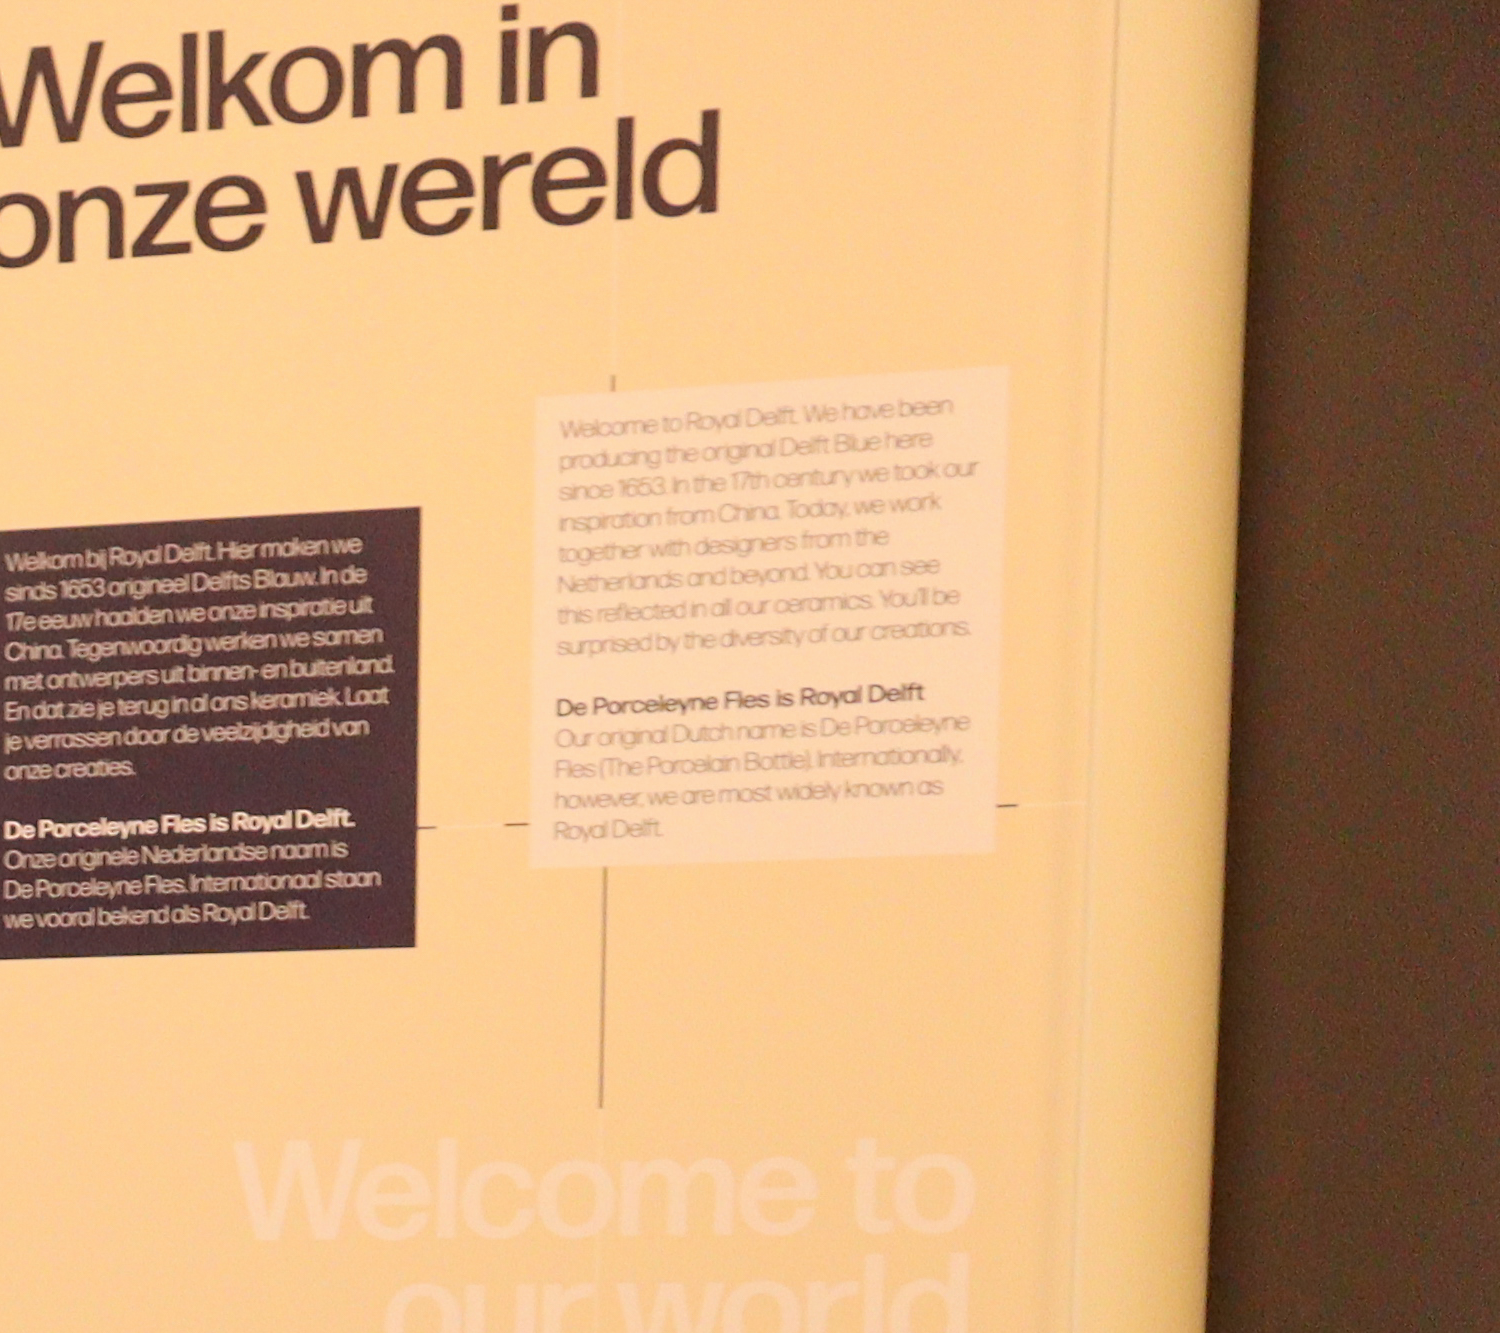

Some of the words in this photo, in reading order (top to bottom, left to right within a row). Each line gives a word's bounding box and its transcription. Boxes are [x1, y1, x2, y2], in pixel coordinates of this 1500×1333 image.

[500, 4, 598, 105] in
[294, 109, 720, 244] wereld
[558, 418, 659, 439] Welcome
[661, 415, 682, 434] to
[686, 411, 740, 432] Royal
[802, 404, 838, 424] We
[841, 402, 894, 421] have
[896, 399, 954, 418] been
[558, 449, 661, 474] producing
[666, 445, 700, 464] the
[701, 439, 776, 465] original
[779, 435, 829, 457] Delft
[834, 432, 881, 454] Blue
[884, 432, 934, 450] here
[558, 511, 662, 534] inspiration
[666, 507, 714, 526] from
[853, 498, 886, 515] we
[888, 492, 942, 513] work
[4, 551, 84, 572] Welkom
[84, 549, 106, 570] bij
[108, 546, 163, 568] Royal
[216, 541, 258, 560] Hier
[260, 538, 330, 558] maken
[330, 538, 364, 554] we
[558, 542, 646, 567] together
[648, 538, 690, 558] with
[694, 535, 797, 559] designers
[801, 530, 851, 550] from
[854, 528, 890, 548] the
[4, 581, 57, 602] sinds
[59, 577, 106, 599] 1653
[108, 574, 190, 600] origineel
[191, 571, 252, 592] Delfts
[320, 566, 338, 585] In
[340, 565, 368, 585] de
[557, 570, 684, 593] Netherlands
[686, 567, 726, 588] and
[813, 561, 852, 580] You
[856, 561, 896, 579] can
[899, 558, 940, 576] see
[4, 611, 37, 631] 17e
[38, 613, 93, 630] eeuw
[94, 606, 174, 627] haalden
[174, 606, 206, 623] we
[206, 604, 257, 621] onze
[258, 598, 347, 621] inspiratie
[348, 595, 374, 614] uit
[556, 607, 593, 625] this
[596, 600, 686, 623] reflected
[690, 601, 706, 618] in
[710, 597, 732, 617] all
[735, 599, 770, 616] our
[878, 586, 928, 608] You'll
[931, 588, 961, 606] be
[65, 634, 202, 663] Tegenwoordig
[203, 631, 278, 652] werken
[278, 632, 310, 648] we
[312, 628, 384, 647] samen
[556, 634, 652, 658] surprised
[655, 633, 680, 653] by
[682, 631, 716, 650] the
[719, 627, 806, 648] diversity
[807, 623, 830, 645] of
[832, 626, 868, 642] our
[4, 673, 44, 691] met
[46, 669, 159, 690] ontwerpers
[160, 666, 185, 684] uit
[186, 664, 258, 683] binnen-
[260, 663, 288, 680] en
[4, 701, 30, 721] En
[31, 701, 64, 720] dat
[65, 701, 95, 719] zie
[96, 702, 115, 720] je
[116, 699, 169, 719] terug
[170, 696, 189, 713] in
[190, 694, 208, 713] al
[210, 695, 249, 712] ons
[344, 687, 390, 706] Laat
[556, 698, 588, 718] De
[592, 695, 718, 715] Porceleyne
[723, 690, 770, 710] Fles
[775, 690, 794, 708] is
[799, 685, 862, 708] Royal
[867, 682, 926, 703] Delft
[4, 734, 22, 754] je
[23, 731, 122, 750] verrassen
[122, 727, 170, 746] door
[171, 725, 200, 743] de
[200, 718, 330, 744] veelzijdigheid
[331, 720, 370, 737] van
[555, 728, 593, 748] Our
[596, 725, 668, 750] original
[672, 723, 734, 744] Dutch
[736, 723, 796, 740] name
[800, 722, 817, 738] is
[820, 717, 850, 737] De
[854, 714, 971, 736] Porceleyne
[3, 763, 53, 781] onze
[554, 758, 596, 779] Fles
[598, 756, 644, 779] (The
[646, 755, 741, 775] Porcelain
[647, 790, 678, 806] we
[680, 789, 715, 805] are
[718, 785, 771, 803] most
[775, 781, 840, 802] widely
[843, 780, 914, 798] known
[918, 779, 944, 796] as
[3, 820, 36, 840] De
[37, 817, 158, 839] Porceleyne
[160, 814, 207, 834] Fles
[208, 813, 230, 832] is
[231, 810, 292, 834] Royal
[2, 850, 57, 870] Onze
[58, 847, 140, 871] originele
[140, 842, 268, 864] Nederlandse
[269, 843, 329, 860] naam
[330, 841, 350, 858] is
[2, 880, 34, 900] De
[34, 878, 143, 899] Porceleyne
[190, 870, 322, 893] Internationaal
[324, 871, 382, 889] staan
[2, 914, 34, 929] we
[34, 908, 96, 928] vooral
[96, 905, 170, 926] bekend
[170, 905, 201, 923] als
[202, 903, 256, 925] Royal
[234, 1138, 818, 1241] Welcome
[847, 1137, 976, 1234] to
